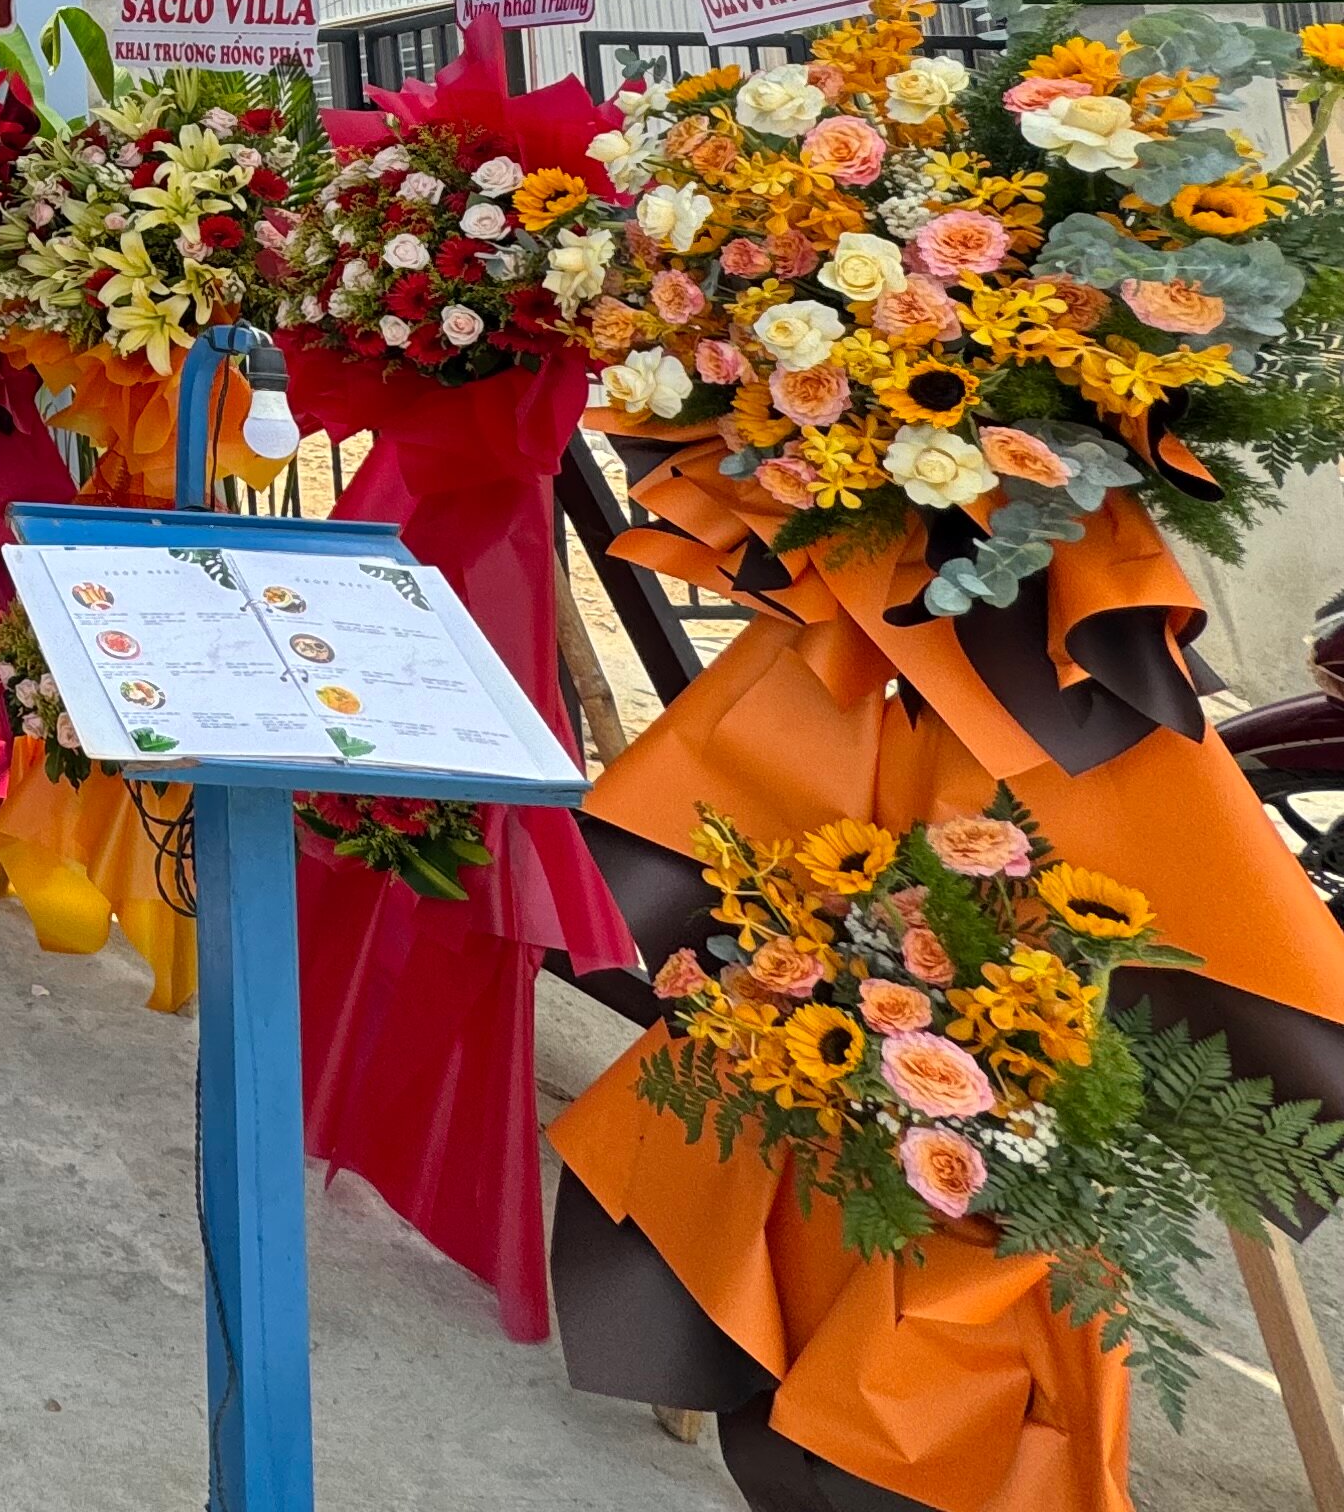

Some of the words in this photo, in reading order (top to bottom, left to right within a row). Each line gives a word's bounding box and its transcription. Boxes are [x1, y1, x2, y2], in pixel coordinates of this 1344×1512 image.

[115, 42, 150, 61] KHAI
[220, 35, 264, 65] HỒNG
[270, 41, 314, 67] PHÁT
